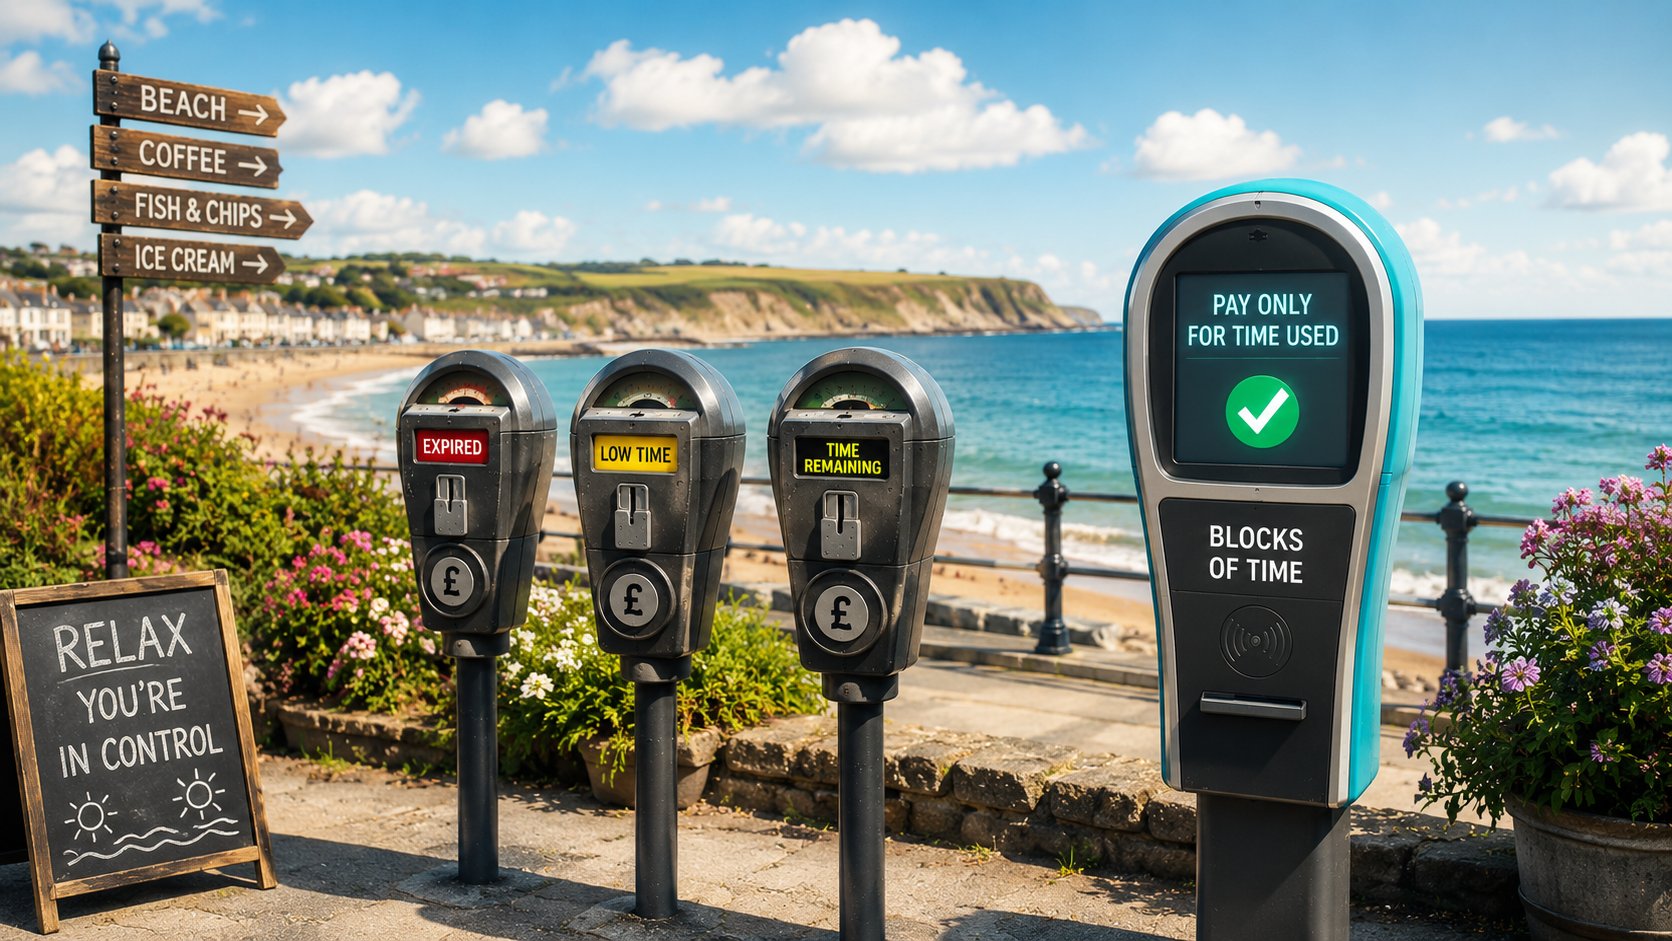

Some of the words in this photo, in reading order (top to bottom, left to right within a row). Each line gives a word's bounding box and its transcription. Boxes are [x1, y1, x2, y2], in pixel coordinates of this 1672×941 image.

[140, 84, 226, 121] BEACH
[139, 139, 227, 175] COFFEE
[135, 192, 181, 221] FISH
[186, 197, 201, 222] &
[205, 200, 263, 228] CHIPS
[135, 244, 166, 271] ICE
[171, 247, 235, 274] CREAM
[1213, 293, 1251, 316] PAY
[1257, 293, 1312, 315] ONLY
[1188, 325, 1226, 346] FOR
[1232, 325, 1279, 346] TIME
[1286, 325, 1339, 346] USED
[423, 438, 482, 456] EXPIRED
[600, 446, 632, 463] LOW
[636, 447, 671, 463] TIME
[826, 442, 860, 459] TIME
[804, 458, 882, 475] REMAINING
[1209, 524, 1304, 552] BLOCKS
[443, 565, 460, 597] £
[1209, 556, 1239, 580] OF
[1246, 558, 1303, 584] TIME
[623, 582, 643, 617] £
[830, 595, 852, 630] £
[53, 612, 192, 673] RELAX
[76, 677, 187, 724] YOU'RE
[59, 742, 90, 779] IN
[101, 723, 224, 771] CONTROL
